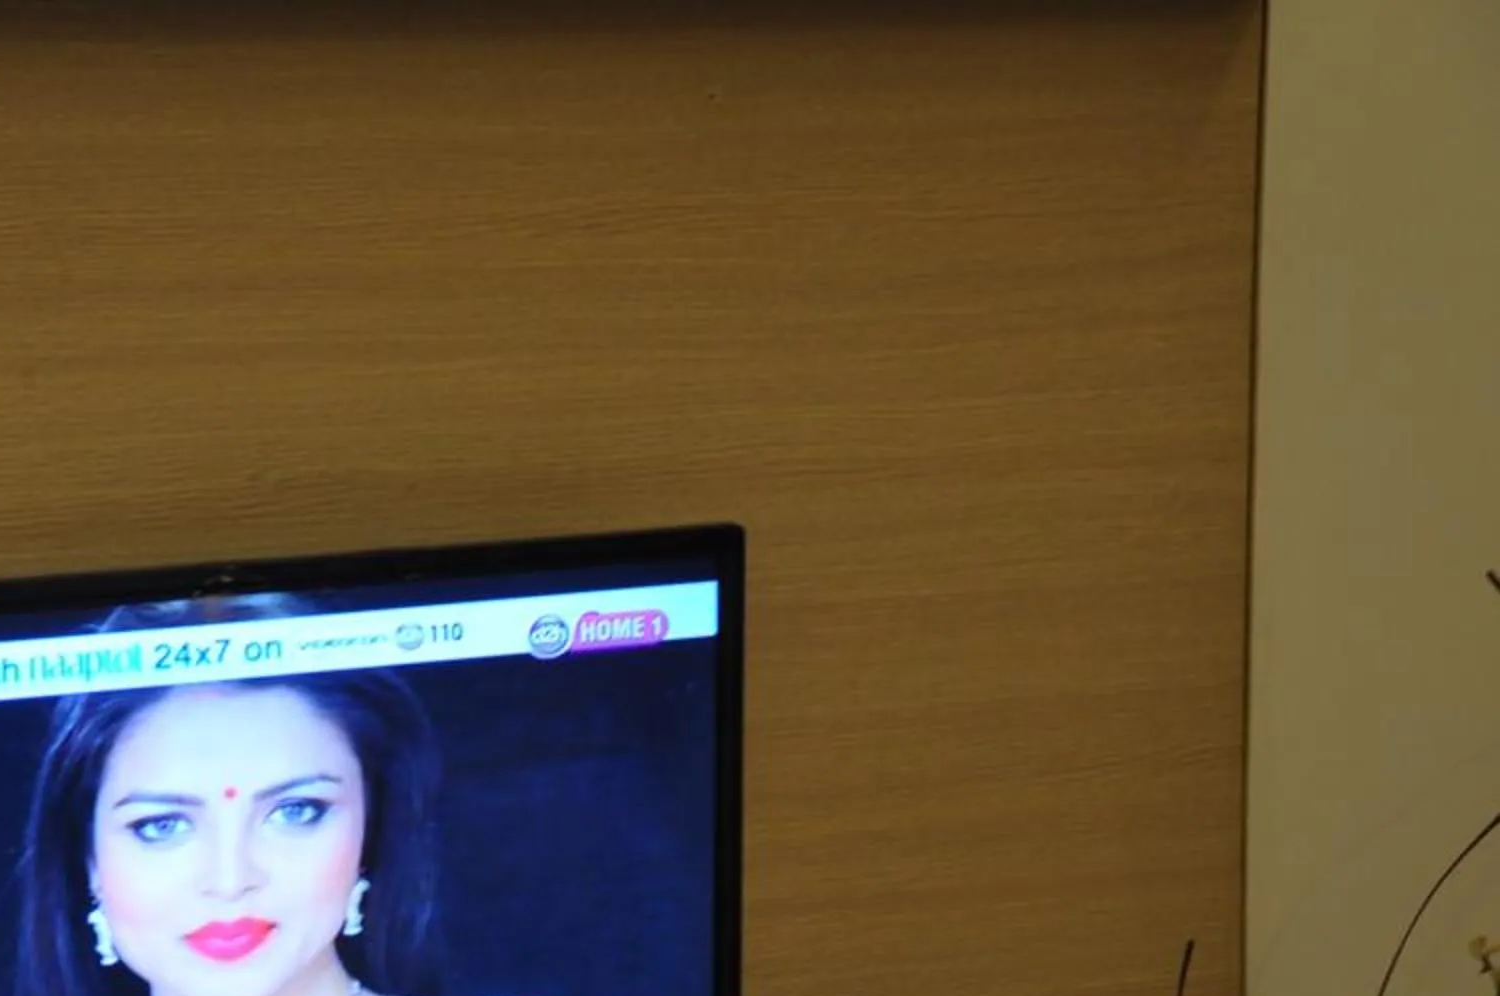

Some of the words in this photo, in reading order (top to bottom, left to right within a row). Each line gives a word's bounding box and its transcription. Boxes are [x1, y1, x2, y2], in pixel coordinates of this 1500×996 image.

[153, 639, 231, 670] 24x7
[244, 640, 282, 662] on
[430, 622, 464, 642] 110
[579, 615, 645, 643] HOME
[651, 615, 663, 635] 1
